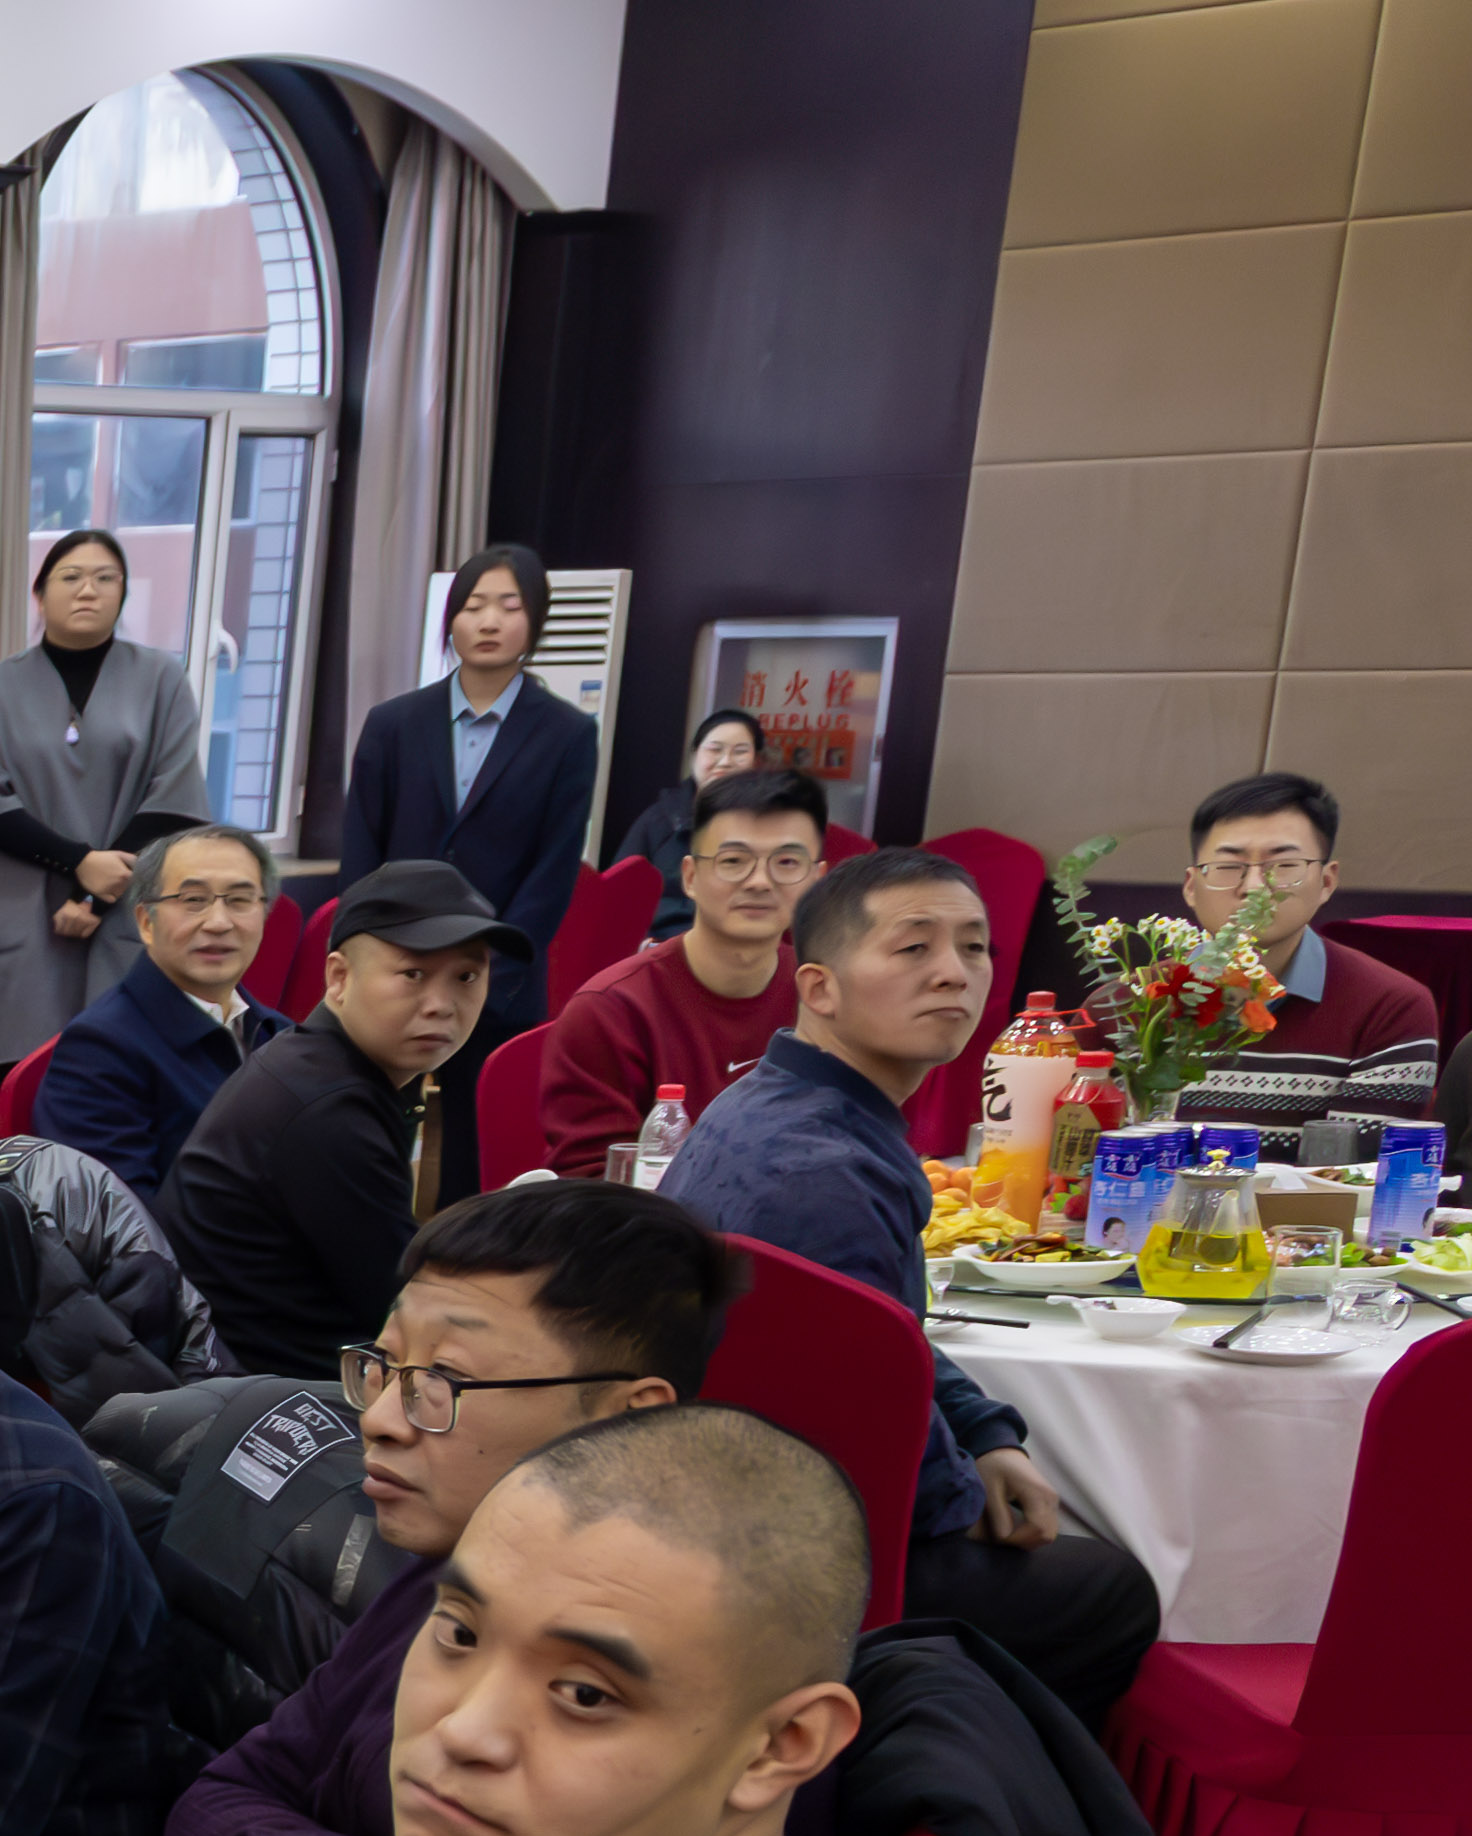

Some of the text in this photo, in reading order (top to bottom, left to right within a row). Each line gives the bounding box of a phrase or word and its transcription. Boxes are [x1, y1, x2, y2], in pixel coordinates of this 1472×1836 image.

[739, 669, 855, 708] 消火栓
[758, 713, 850, 730] REPLUG
